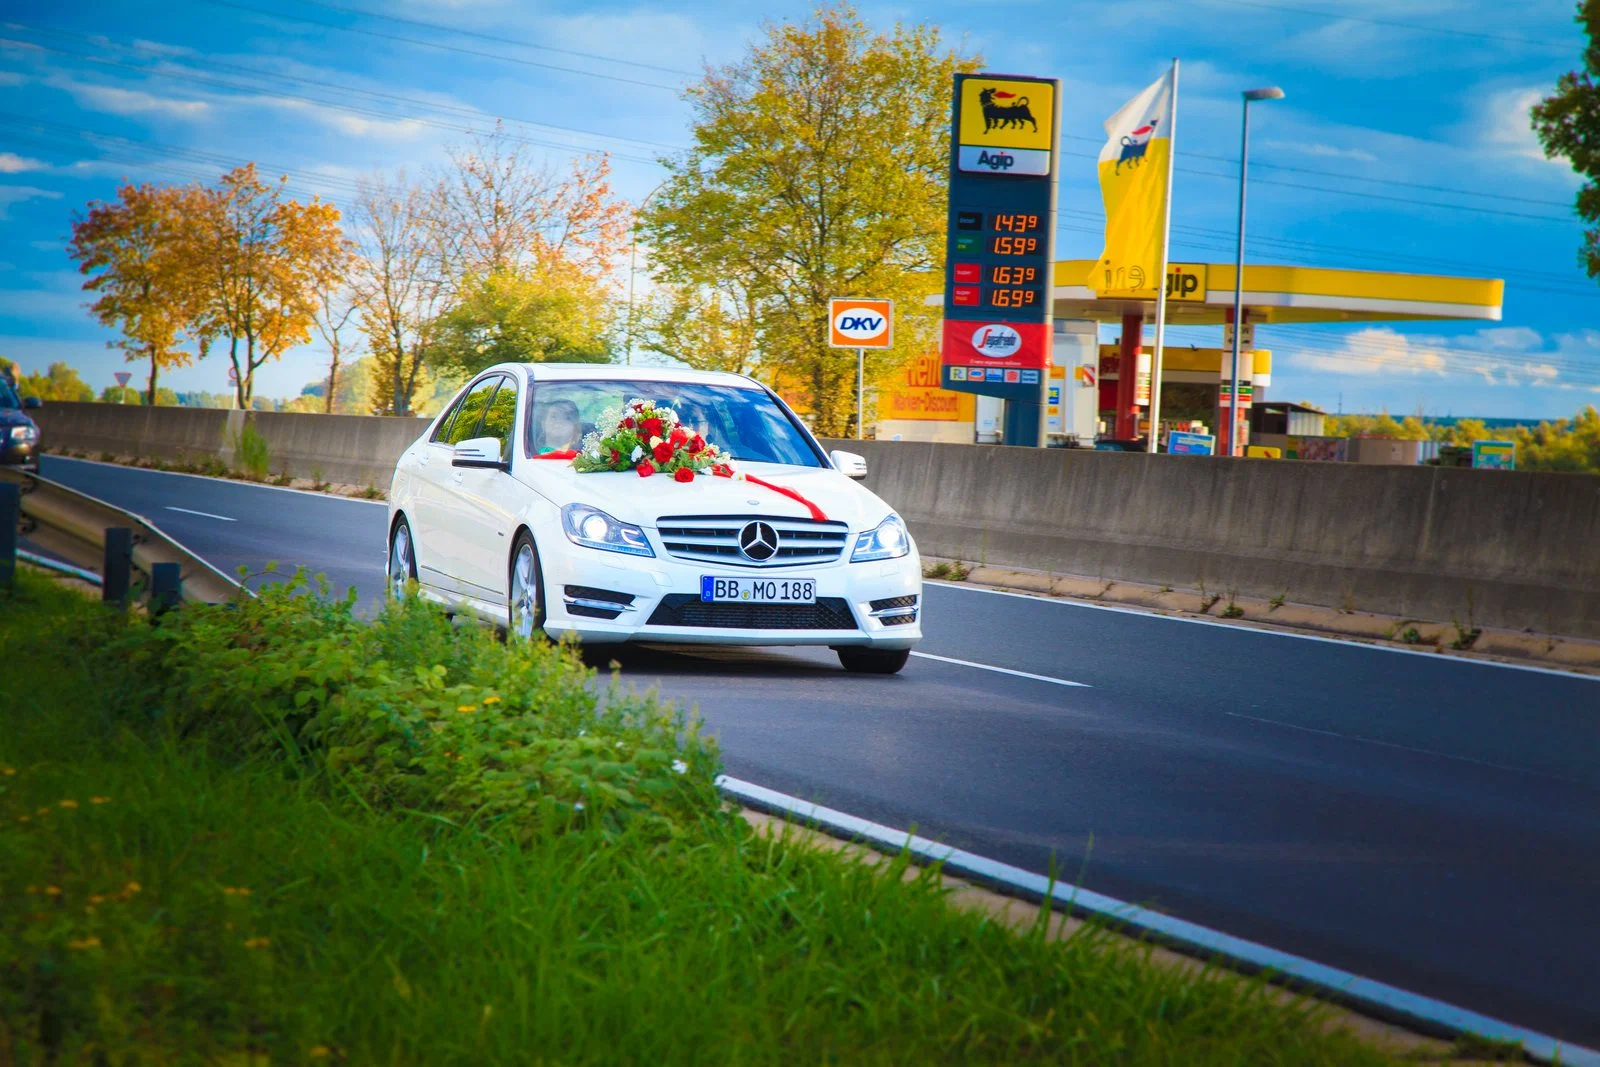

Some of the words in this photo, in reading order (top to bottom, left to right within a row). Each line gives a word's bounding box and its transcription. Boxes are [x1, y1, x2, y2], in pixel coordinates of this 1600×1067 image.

[977, 150, 1014, 170] Agip
[1165, 267, 1198, 298] gip
[839, 316, 882, 331] DKV
[715, 580, 739, 599] BB
[753, 581, 776, 600] MO
[780, 582, 813, 601] 188
